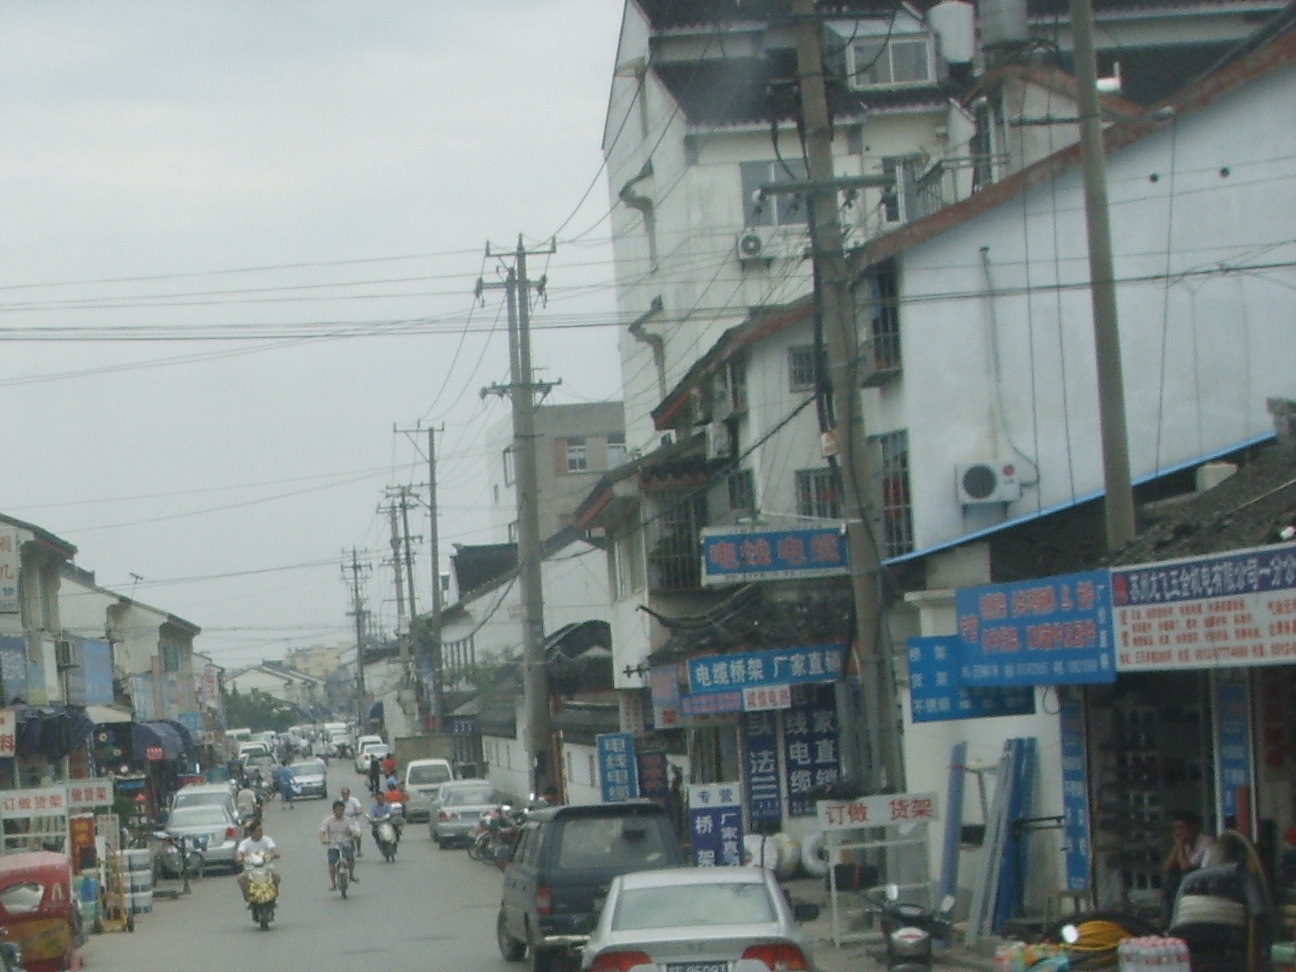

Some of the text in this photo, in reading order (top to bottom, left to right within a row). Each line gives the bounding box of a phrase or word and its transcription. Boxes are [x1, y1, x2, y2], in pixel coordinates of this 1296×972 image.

[696, 657, 764, 689] 电缆桥架
[773, 648, 842, 680] 厂家直销
[825, 802, 868, 825] 订做
[889, 799, 933, 820] 货架
